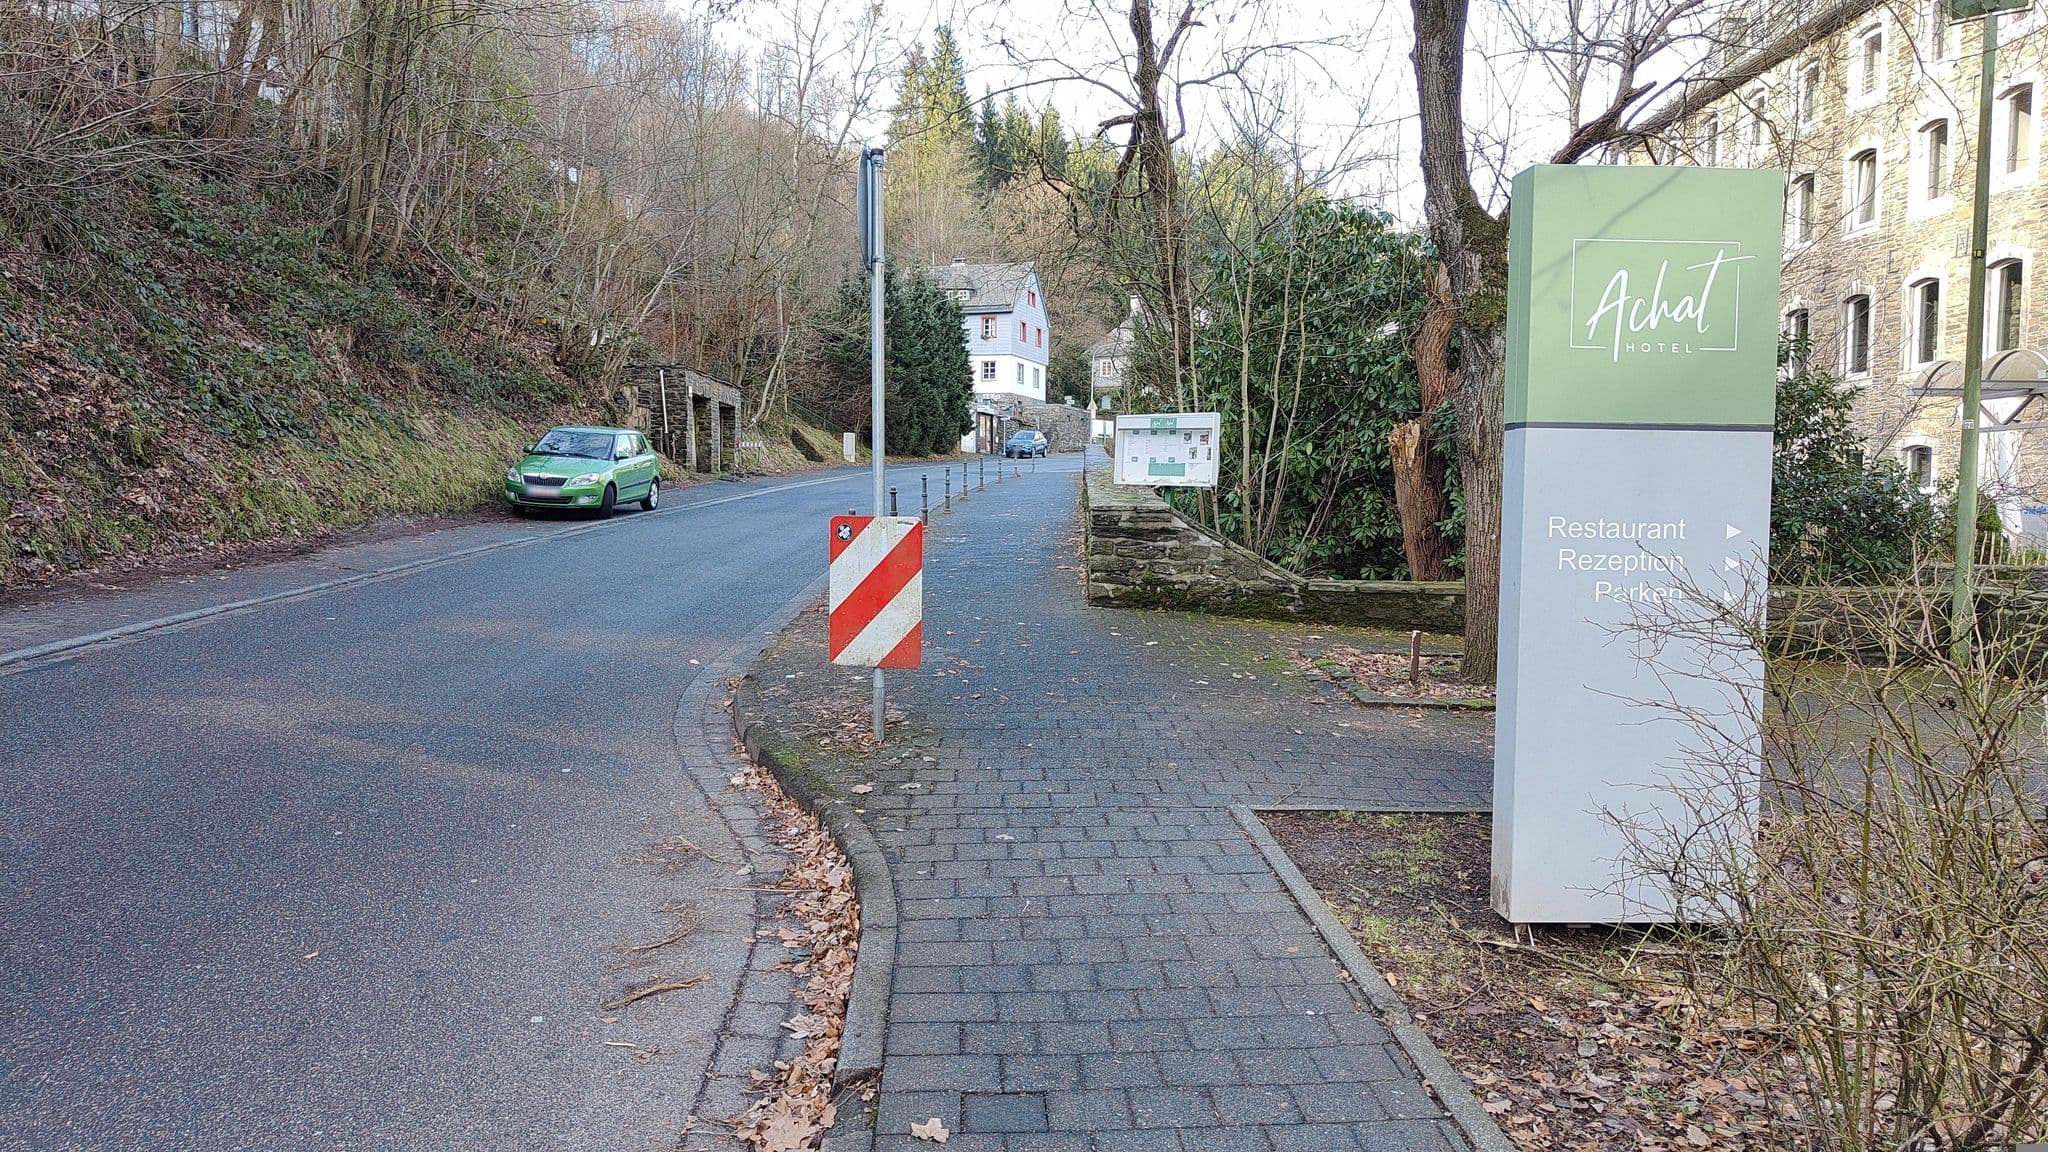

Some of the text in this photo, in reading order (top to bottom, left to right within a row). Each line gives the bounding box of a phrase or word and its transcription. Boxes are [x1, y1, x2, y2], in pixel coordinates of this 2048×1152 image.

[1586, 249, 1757, 362] Achat
[1625, 342, 1693, 354] HOTEL
[1547, 515, 1687, 540] Restaurant
[1557, 548, 1685, 577] Rezeption
[1595, 581, 1684, 604] Parken
